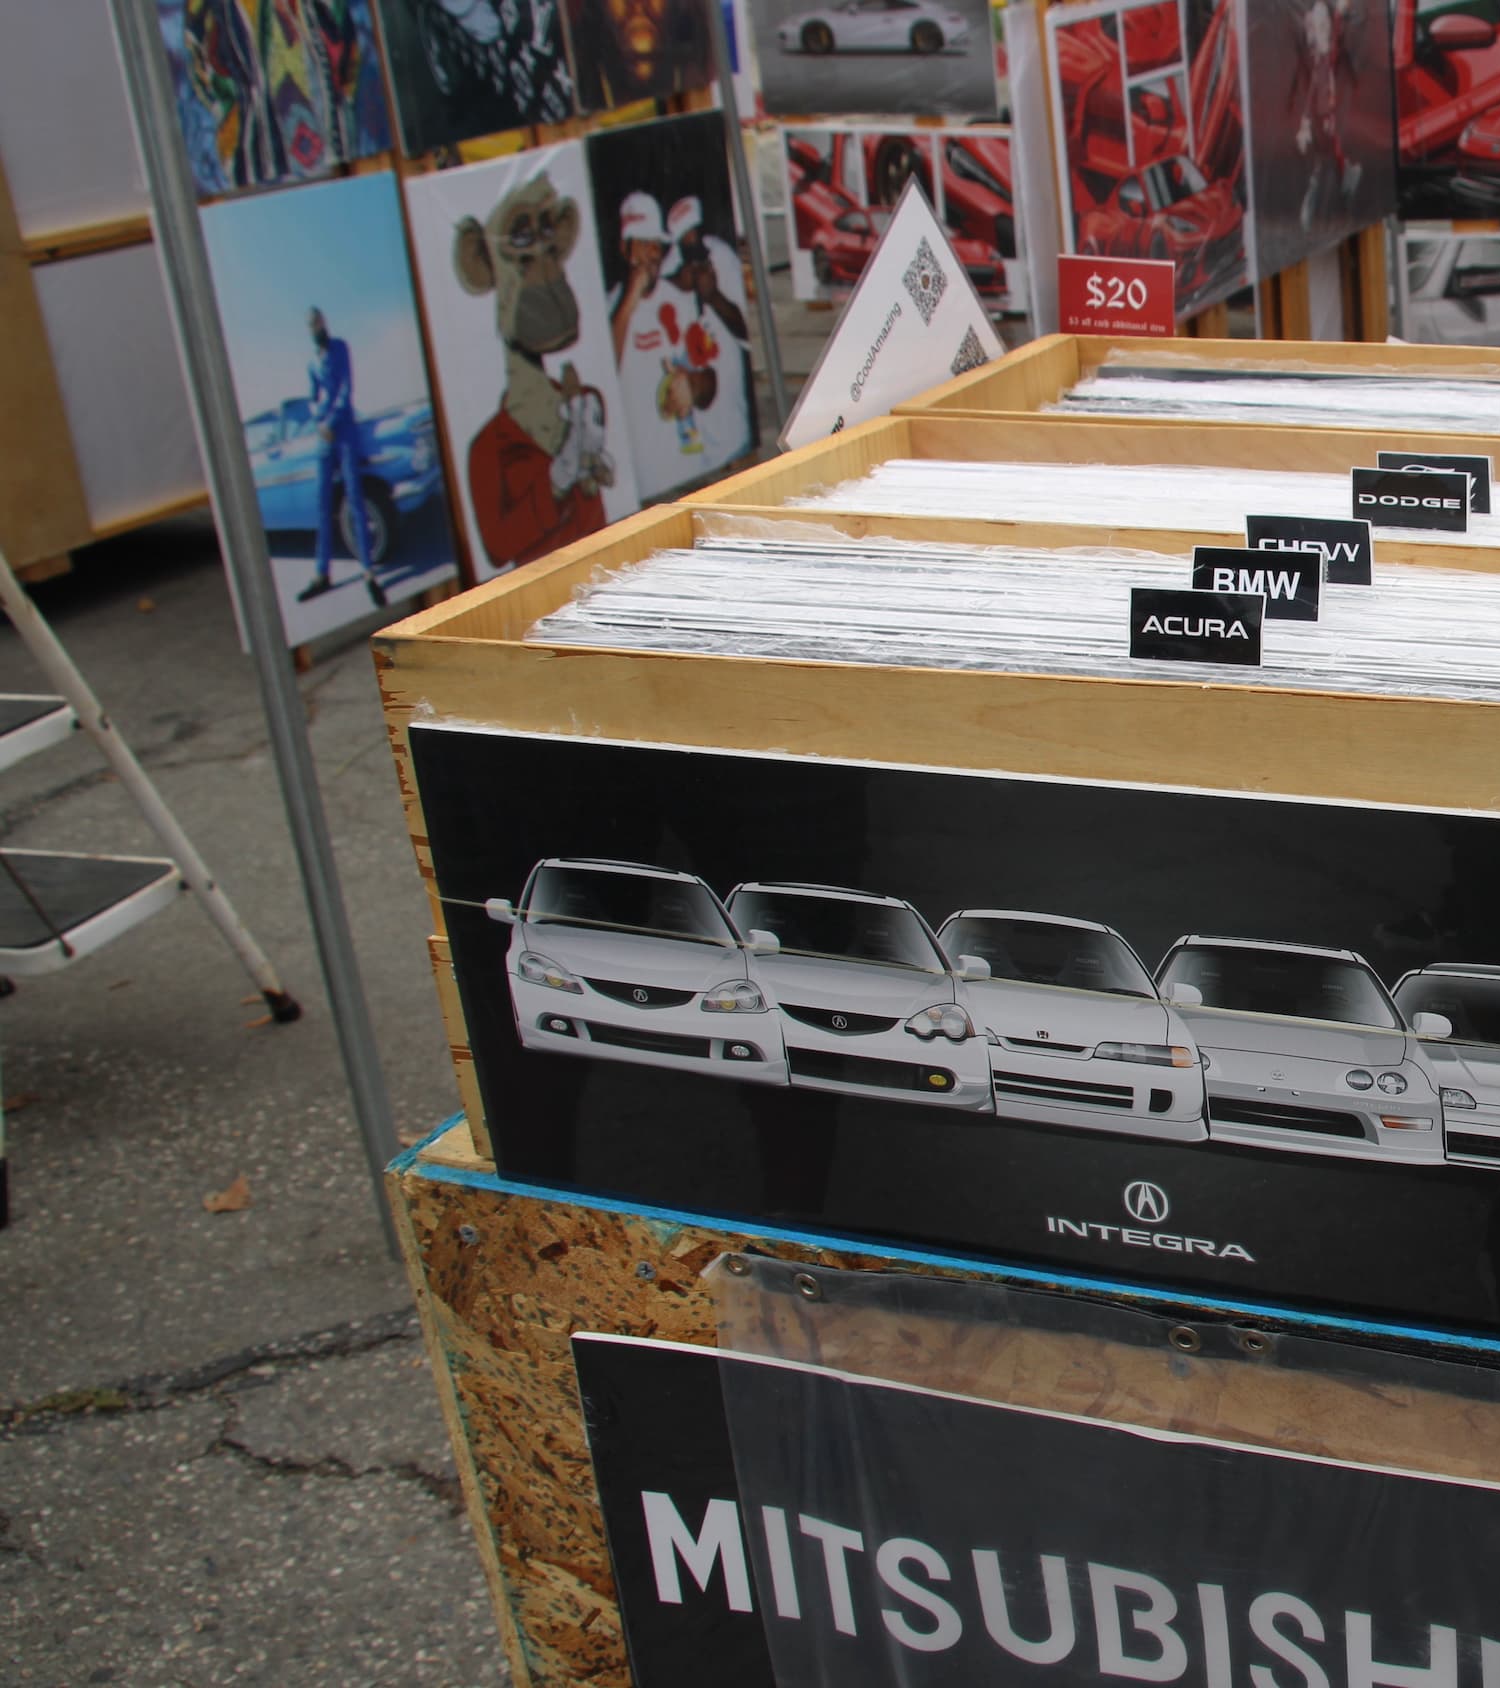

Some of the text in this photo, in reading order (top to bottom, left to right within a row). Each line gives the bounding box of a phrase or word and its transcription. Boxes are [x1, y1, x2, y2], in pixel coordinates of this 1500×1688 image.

[1086, 272, 1147, 310] $20
[850, 302, 902, 402] @CoolAmazing
[1358, 493, 1461, 510] DODGE
[1258, 538, 1360, 562] CHEVY
[1213, 567, 1301, 600] BMW
[1141, 615, 1249, 640] ACURA
[1047, 1216, 1256, 1263] INTEGRA
